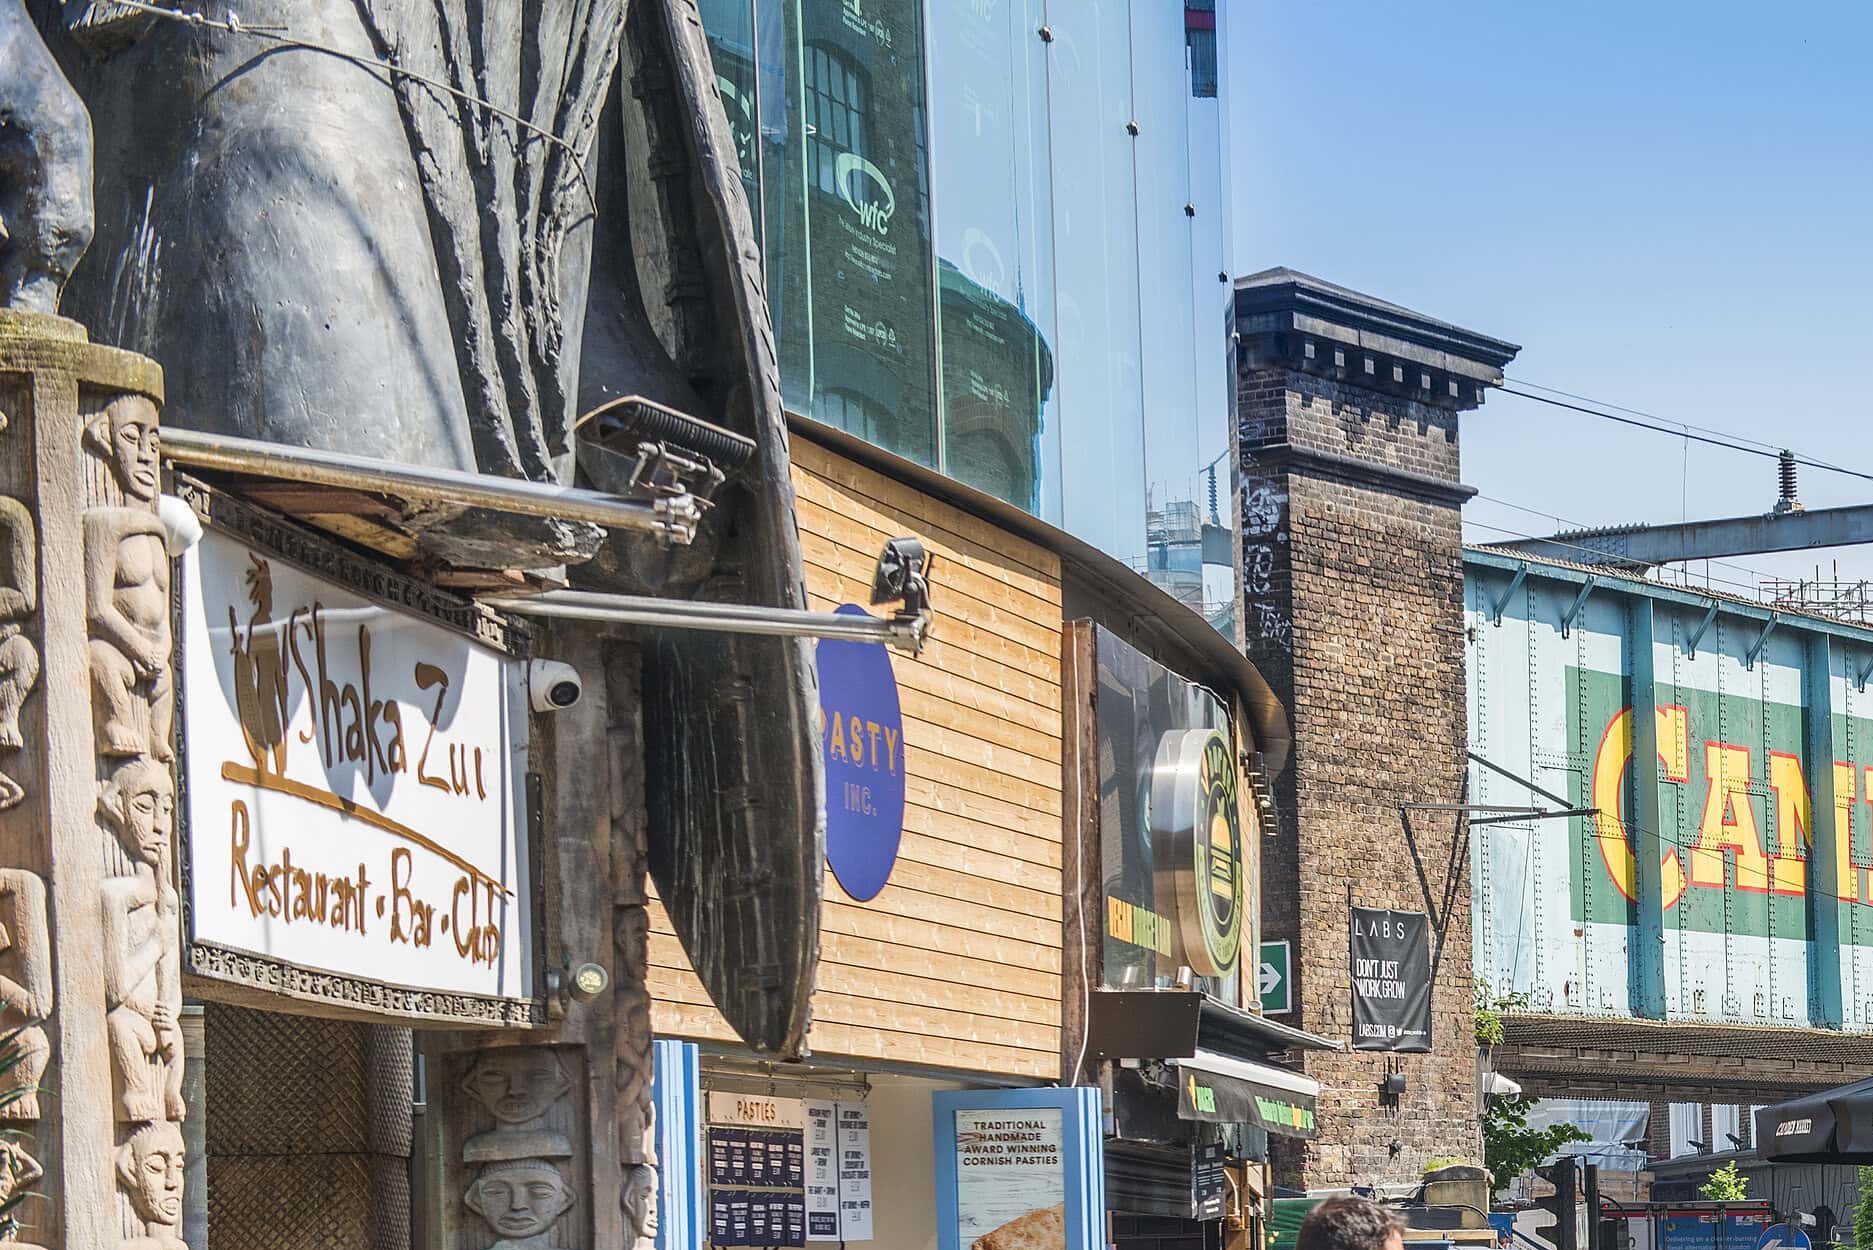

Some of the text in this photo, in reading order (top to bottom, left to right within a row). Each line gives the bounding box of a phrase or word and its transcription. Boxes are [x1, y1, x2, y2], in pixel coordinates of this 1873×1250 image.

[289, 602, 408, 787] Shaka
[819, 706, 898, 777] ASTY
[844, 781, 878, 817] INC.
[230, 799, 500, 970] Restaurant Bar Club
[1355, 919, 1405, 939] LABS
[1356, 958, 1399, 979] DON'T JUST
[1383, 980, 1406, 999] GROW
[737, 1100, 776, 1121] PASTIES
[974, 1121, 1046, 1130] TRADITIONAL
[979, 1132, 1041, 1142] HANDMADE
[965, 1144, 1057, 1154] AWARD WINNING
[963, 1156, 1058, 1166] CORNISH PASTIES
